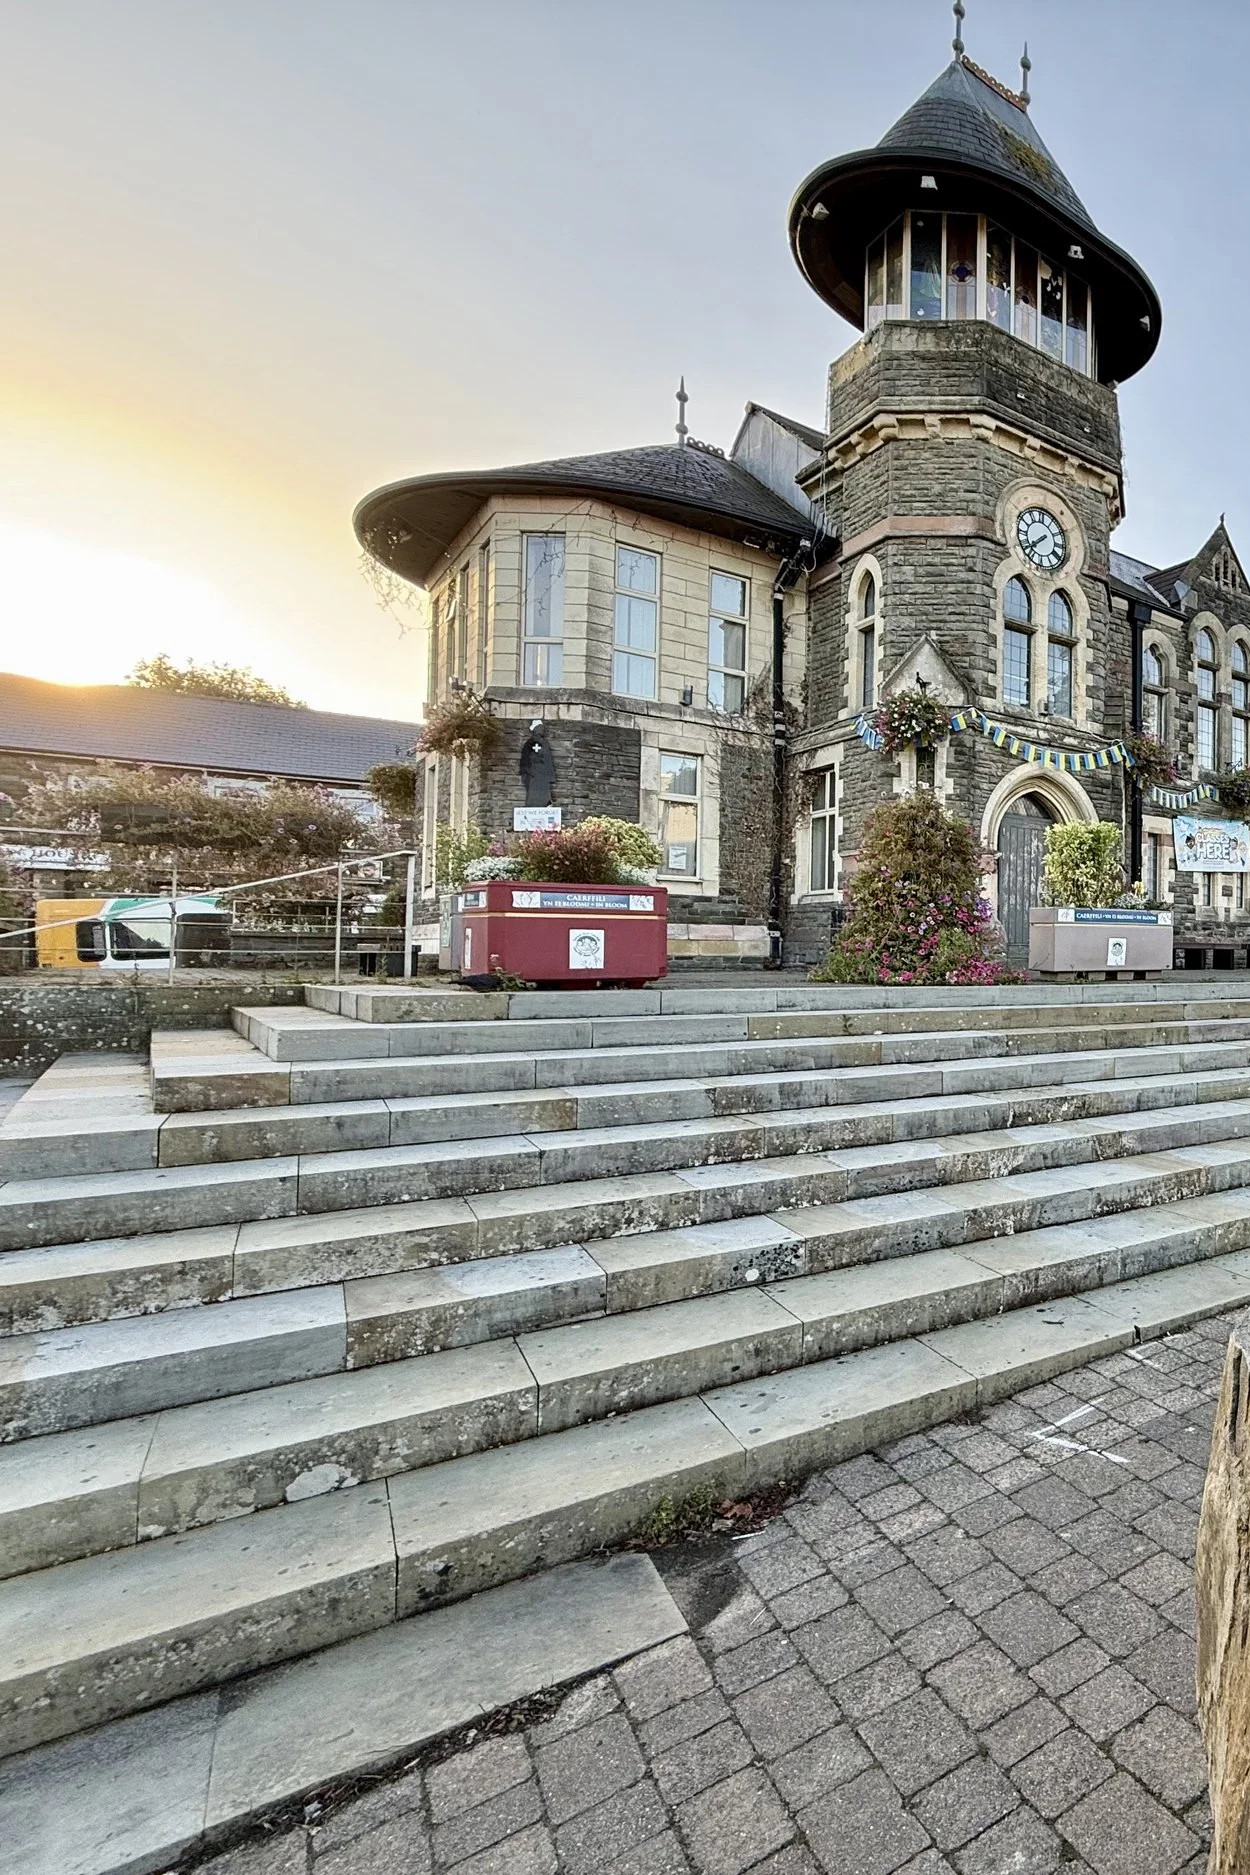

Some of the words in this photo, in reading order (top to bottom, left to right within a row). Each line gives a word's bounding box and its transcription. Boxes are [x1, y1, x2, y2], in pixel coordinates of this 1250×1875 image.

[1195, 832, 1230, 844] CLASSES
[1196, 843, 1230, 860] HERE
[566, 894, 606, 902] CAERFFILI
